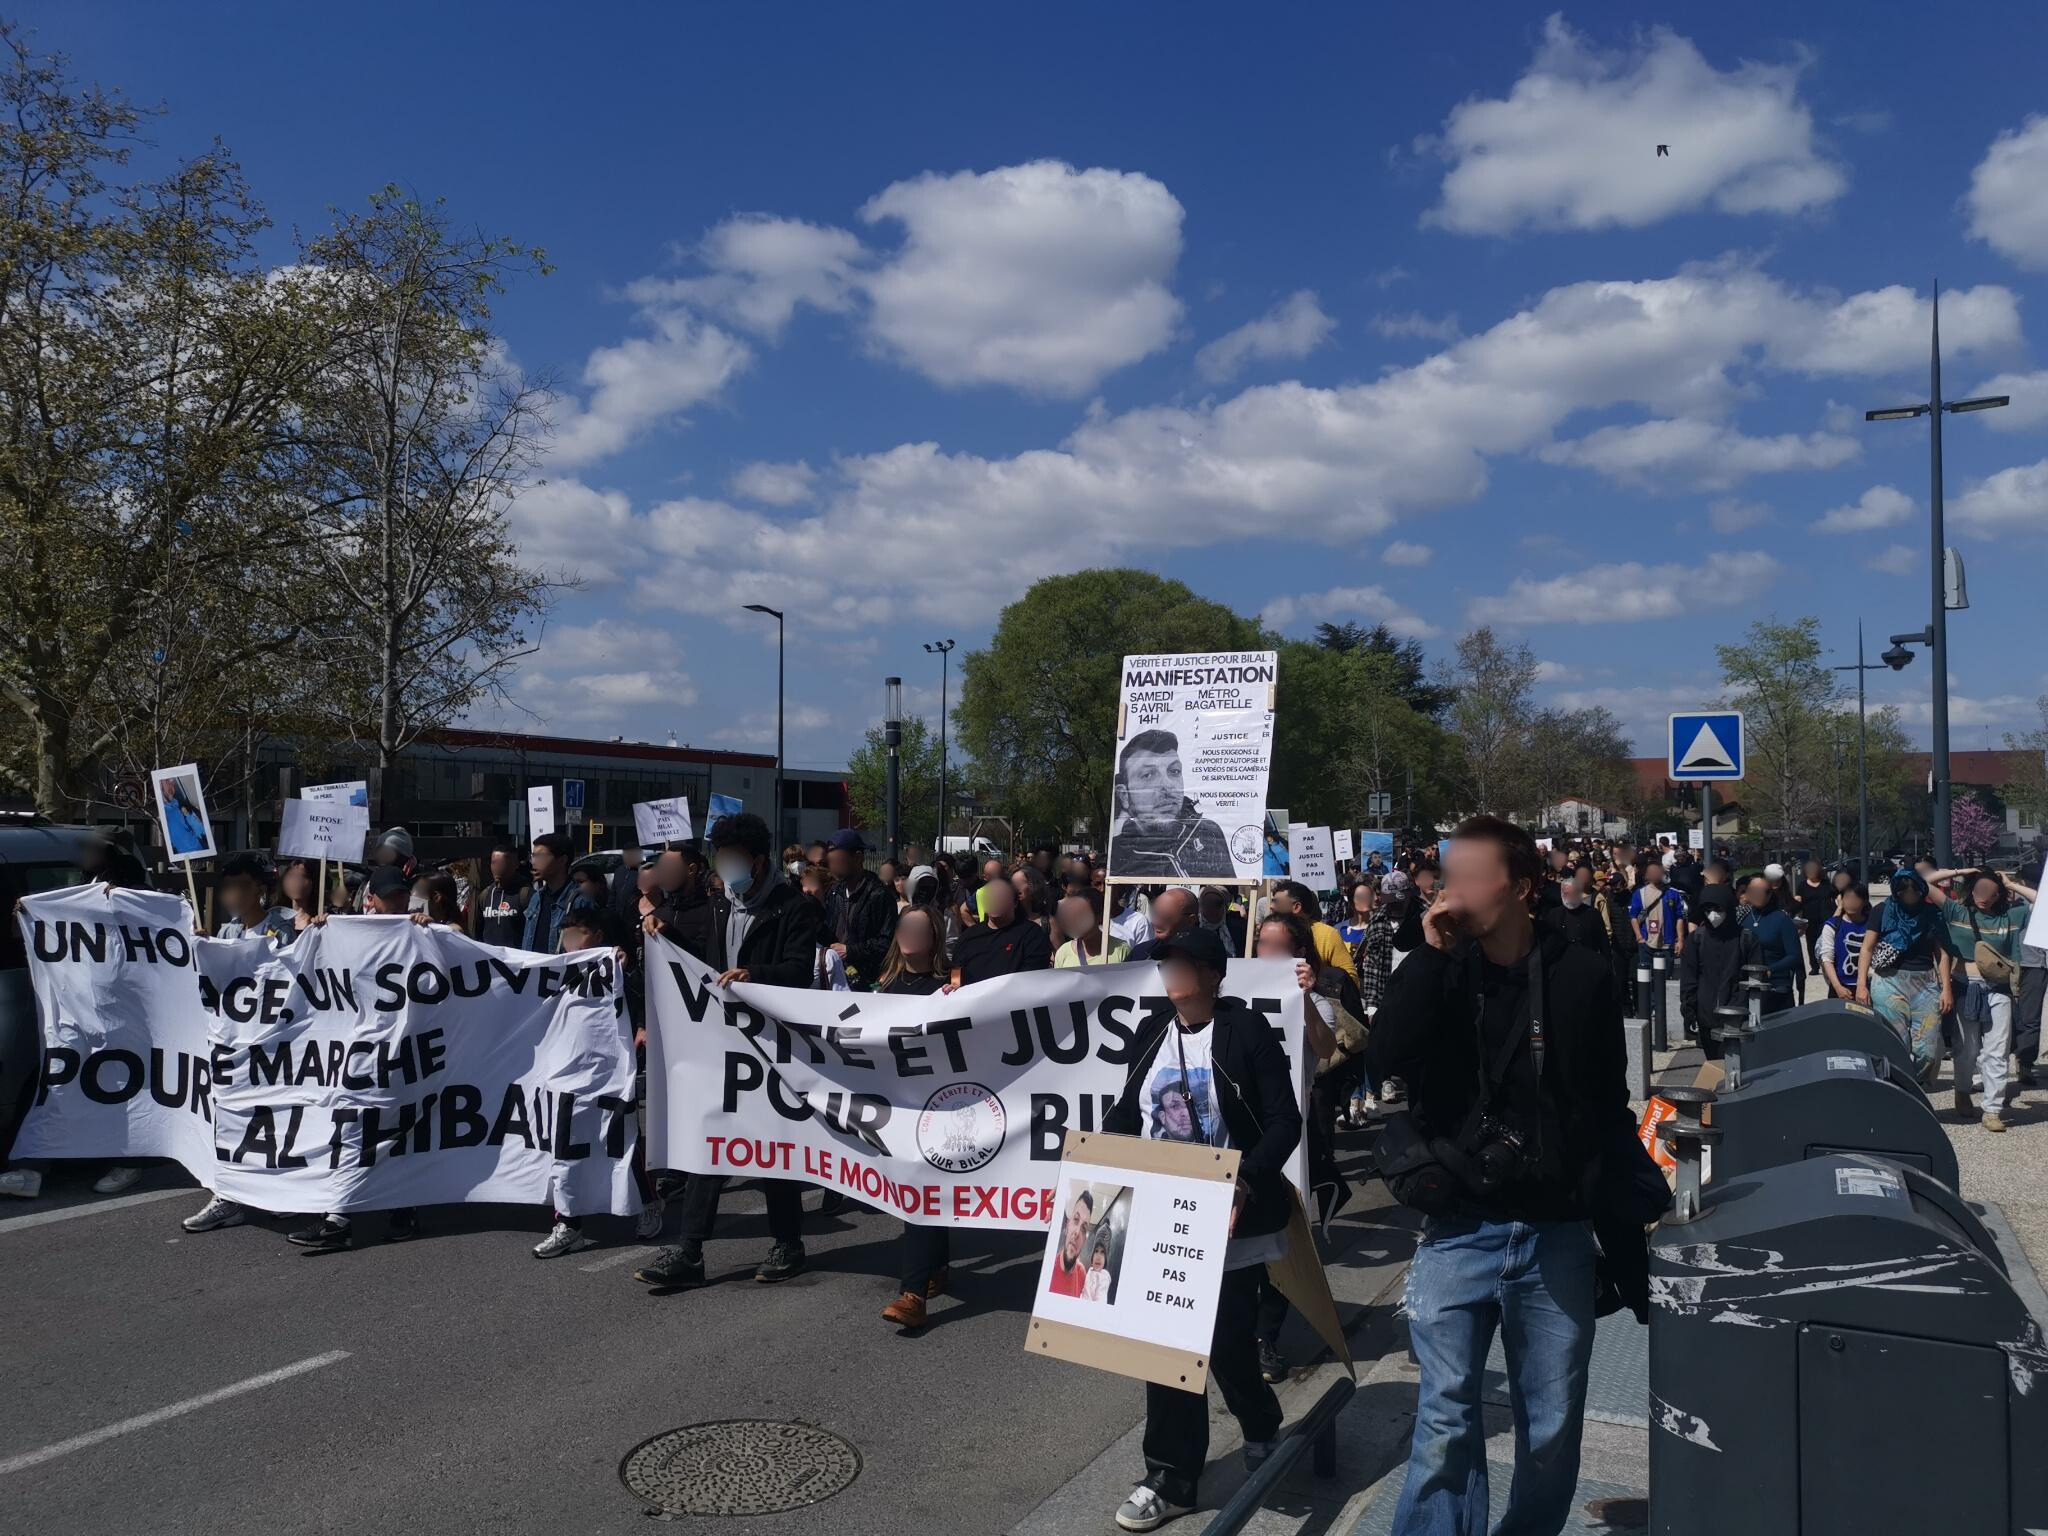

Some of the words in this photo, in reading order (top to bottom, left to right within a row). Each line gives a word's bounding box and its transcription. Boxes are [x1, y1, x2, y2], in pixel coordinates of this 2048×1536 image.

[1129, 656, 1160, 668] VÉRITÉ
[1162, 657, 1172, 667] ET
[1173, 655, 1210, 667] JUSTICE
[1211, 654, 1239, 664] POUR
[1240, 653, 1267, 664] BILAL
[1125, 665, 1273, 688] MANIFESTATION
[1129, 691, 1174, 703] SAMEDI
[1198, 686, 1240, 699] MÉTRO
[1130, 704, 1138, 714] 5
[1139, 702, 1174, 713] AVRIL
[1184, 698, 1253, 711] BAGATELLE
[1138, 714, 1159, 725] 14H
[1211, 732, 1249, 741] JUSTICE
[1220, 748, 1252, 756] EXIGEONS
[1203, 765, 1225, 773] VIDÉOS
[1238, 764, 1268, 772] CAMÉRAS
[309, 814, 343, 825] REPOSE
[313, 833, 333, 842] PAIX
[1298, 852, 1324, 860] JUSTICE
[33, 920, 106, 963] UN
[297, 968, 359, 1013] UN
[888, 1016, 973, 1078] ET
[248, 1027, 447, 1091] MARCHE
[35, 1047, 213, 1124] POUR
[328, 1083, 640, 1170] THIBAULT
[924, 1146, 954, 1170] POUR
[959, 1146, 994, 1170] BILAL
[705, 1136, 796, 1172] TOUT
[804, 1145, 833, 1181] LE
[839, 1157, 941, 1216] MONDE
[1173, 1198, 1197, 1213] PAS
[1173, 1222, 1190, 1236] DE
[1152, 1241, 1205, 1261] JUSTICE
[1162, 1268, 1186, 1283] PAS
[1146, 1290, 1162, 1304] DE
[1165, 1294, 1195, 1310] PAIX
